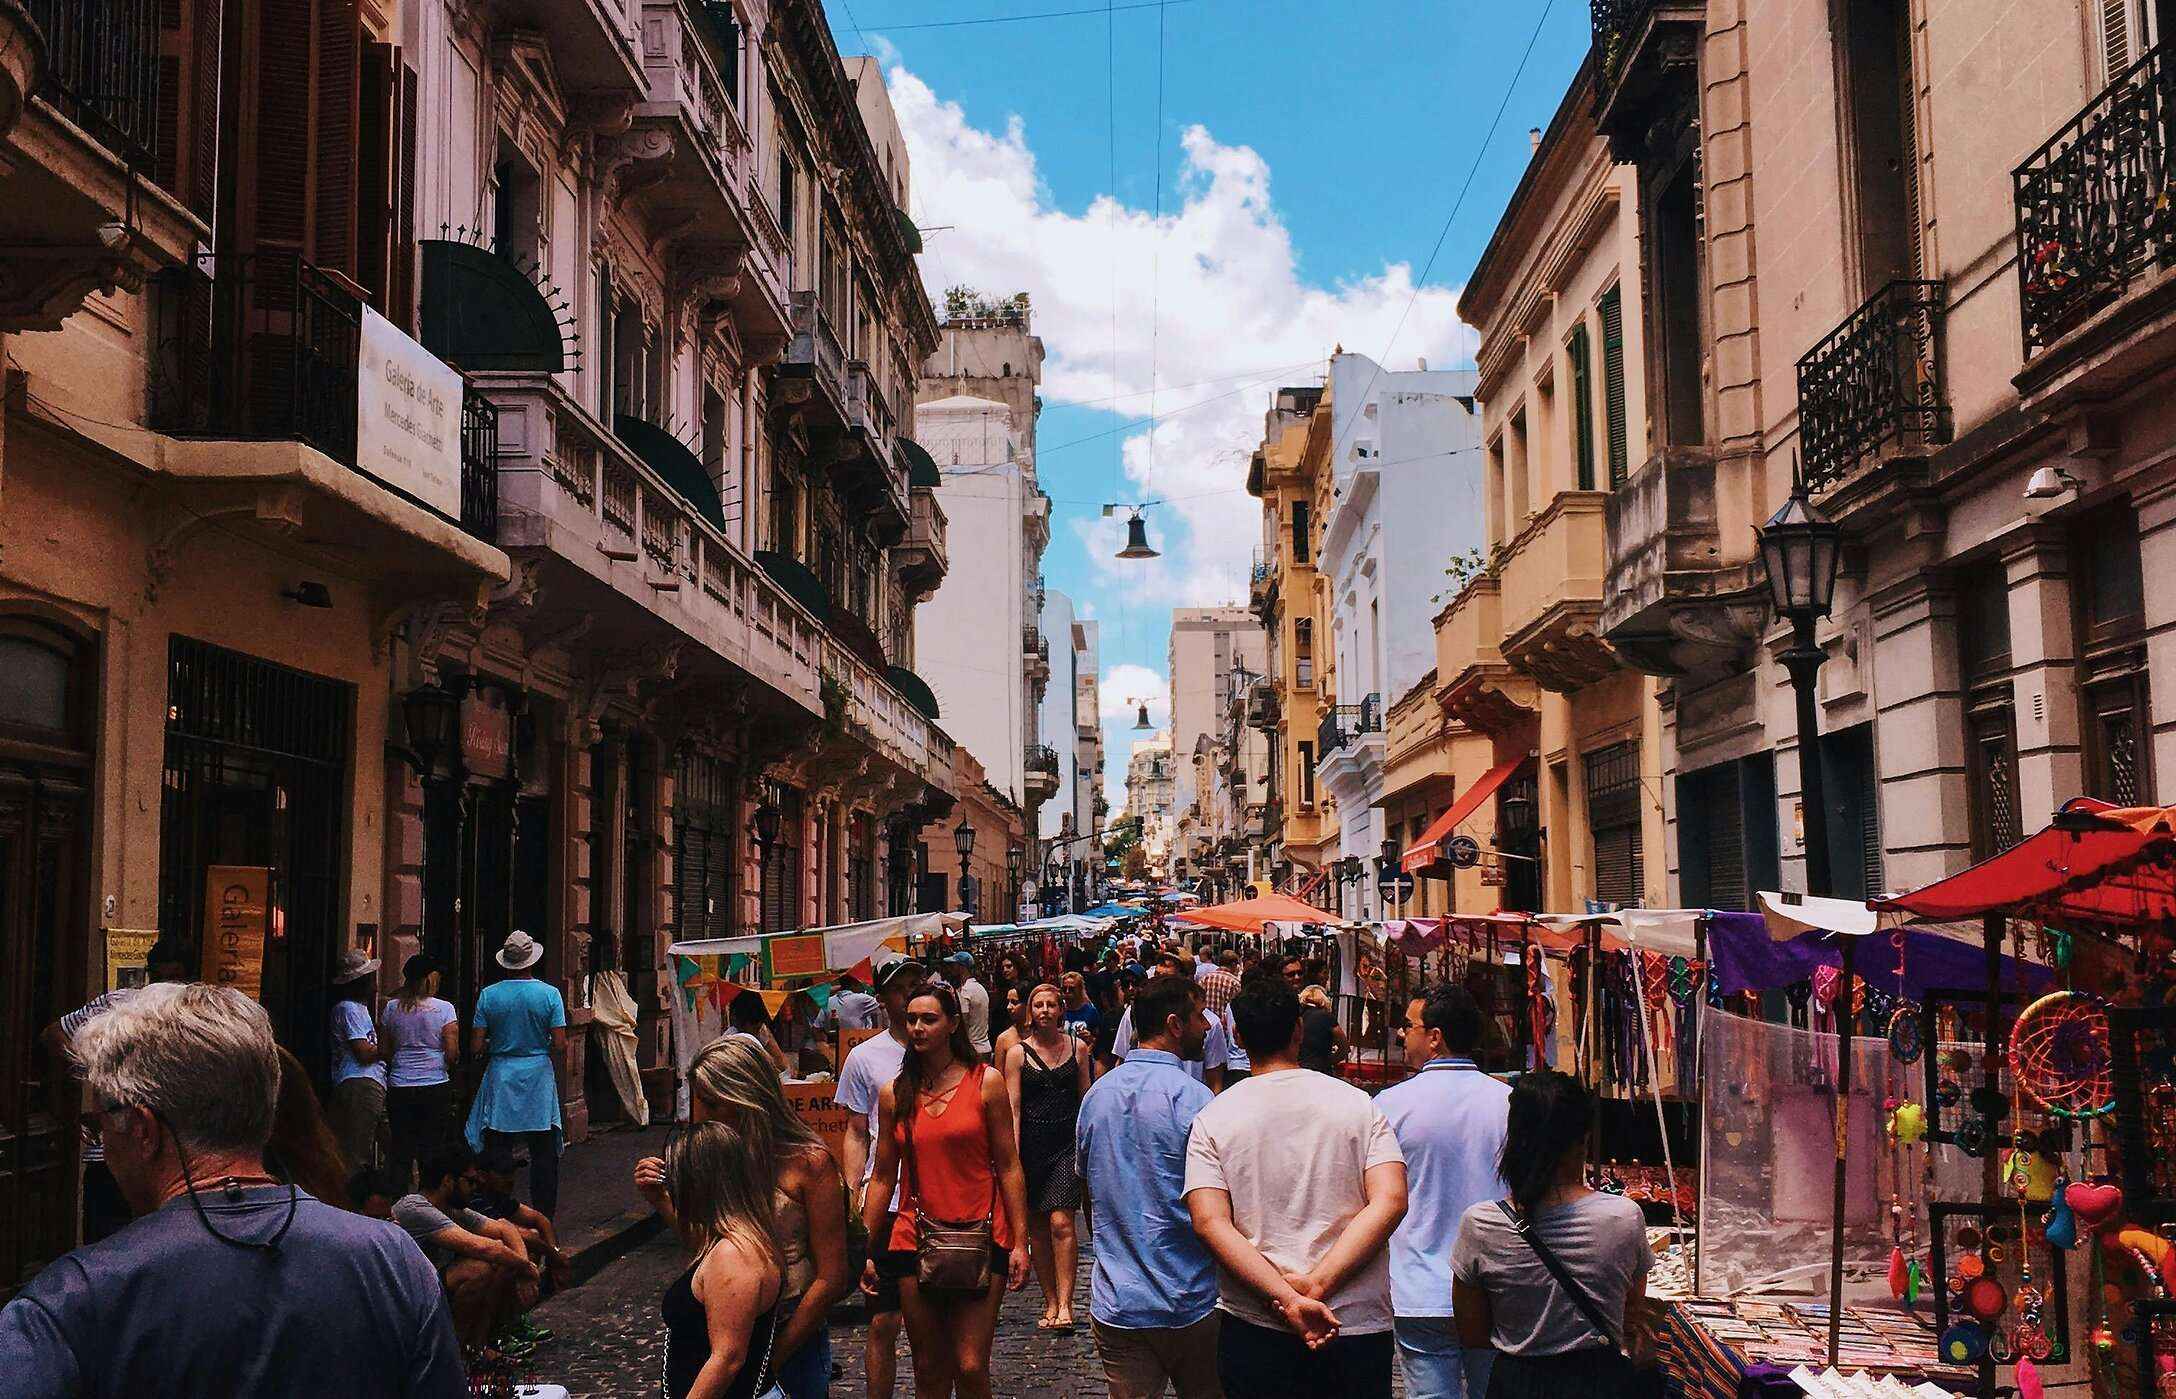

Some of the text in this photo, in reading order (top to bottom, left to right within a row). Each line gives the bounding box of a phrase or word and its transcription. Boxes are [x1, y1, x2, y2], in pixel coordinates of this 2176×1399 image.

[385, 359, 445, 418] Galería de Arte
[217, 884, 249, 983] Galería
